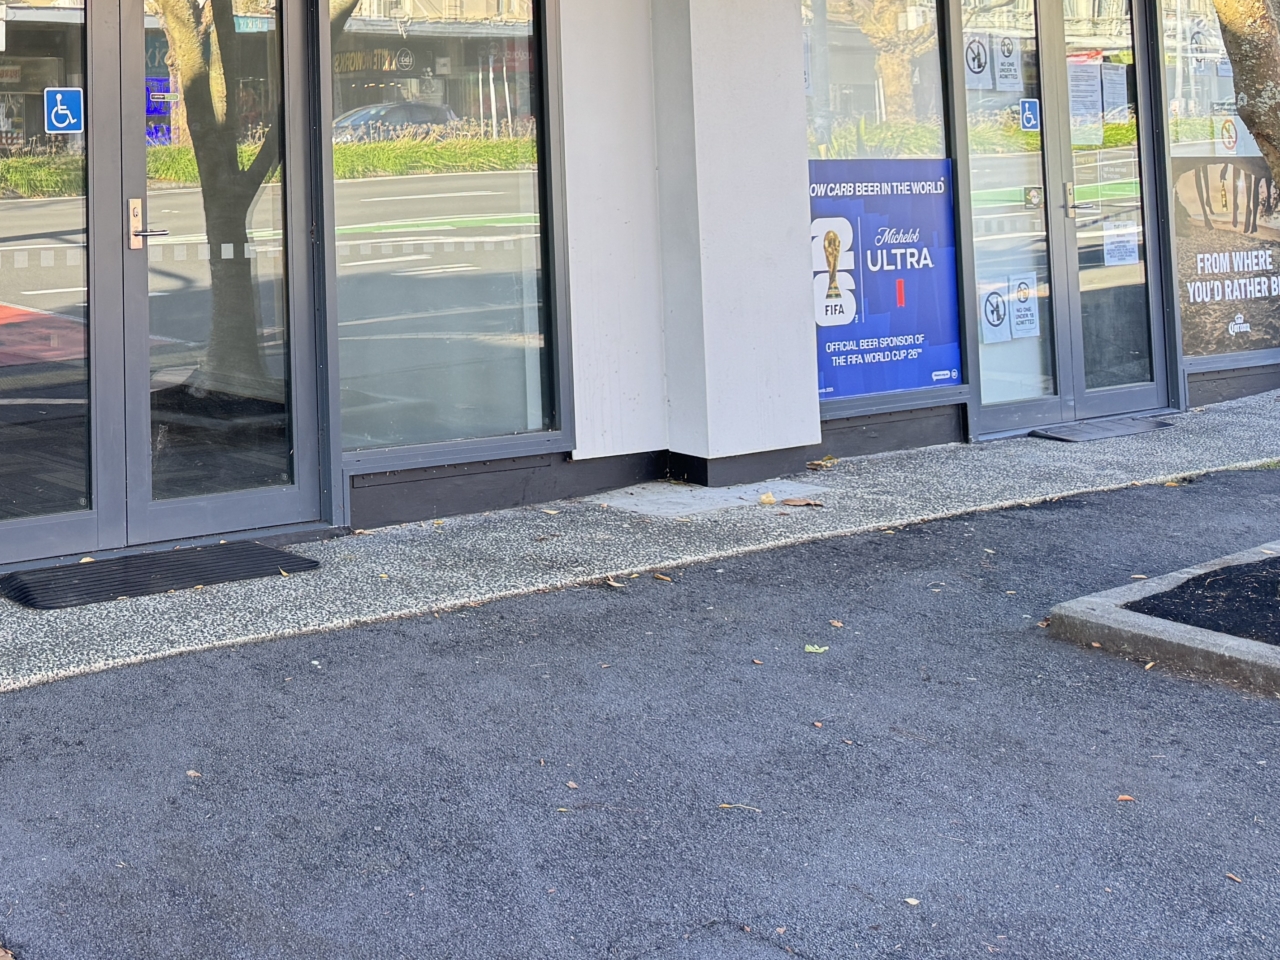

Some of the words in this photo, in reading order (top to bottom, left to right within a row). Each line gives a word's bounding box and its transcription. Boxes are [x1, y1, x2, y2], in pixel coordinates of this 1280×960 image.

[827, 183, 854, 196] CARB
[855, 182, 881, 196] BEER
[881, 182, 891, 195] IN
[892, 182, 911, 195] THE
[875, 227, 920, 246] Michelob
[866, 247, 934, 271] ULTRA
[1196, 252, 1230, 275] FROM
[1231, 249, 1274, 272] WHERE
[1186, 280, 1222, 303] YOU'D
[1224, 276, 1269, 300] RATHER
[1270, 275, 1280, 296] B
[824, 303, 845, 316] FIFA
[825, 340, 858, 353] OFFICIAL
[859, 338, 879, 349] BEER
[879, 335, 914, 348] SPONSOR
[914, 333, 925, 344] OF
[831, 355, 847, 367] THE
[847, 353, 864, 365] FIFA
[864, 351, 891, 363] WORLD
[891, 349, 908, 361] CUP
